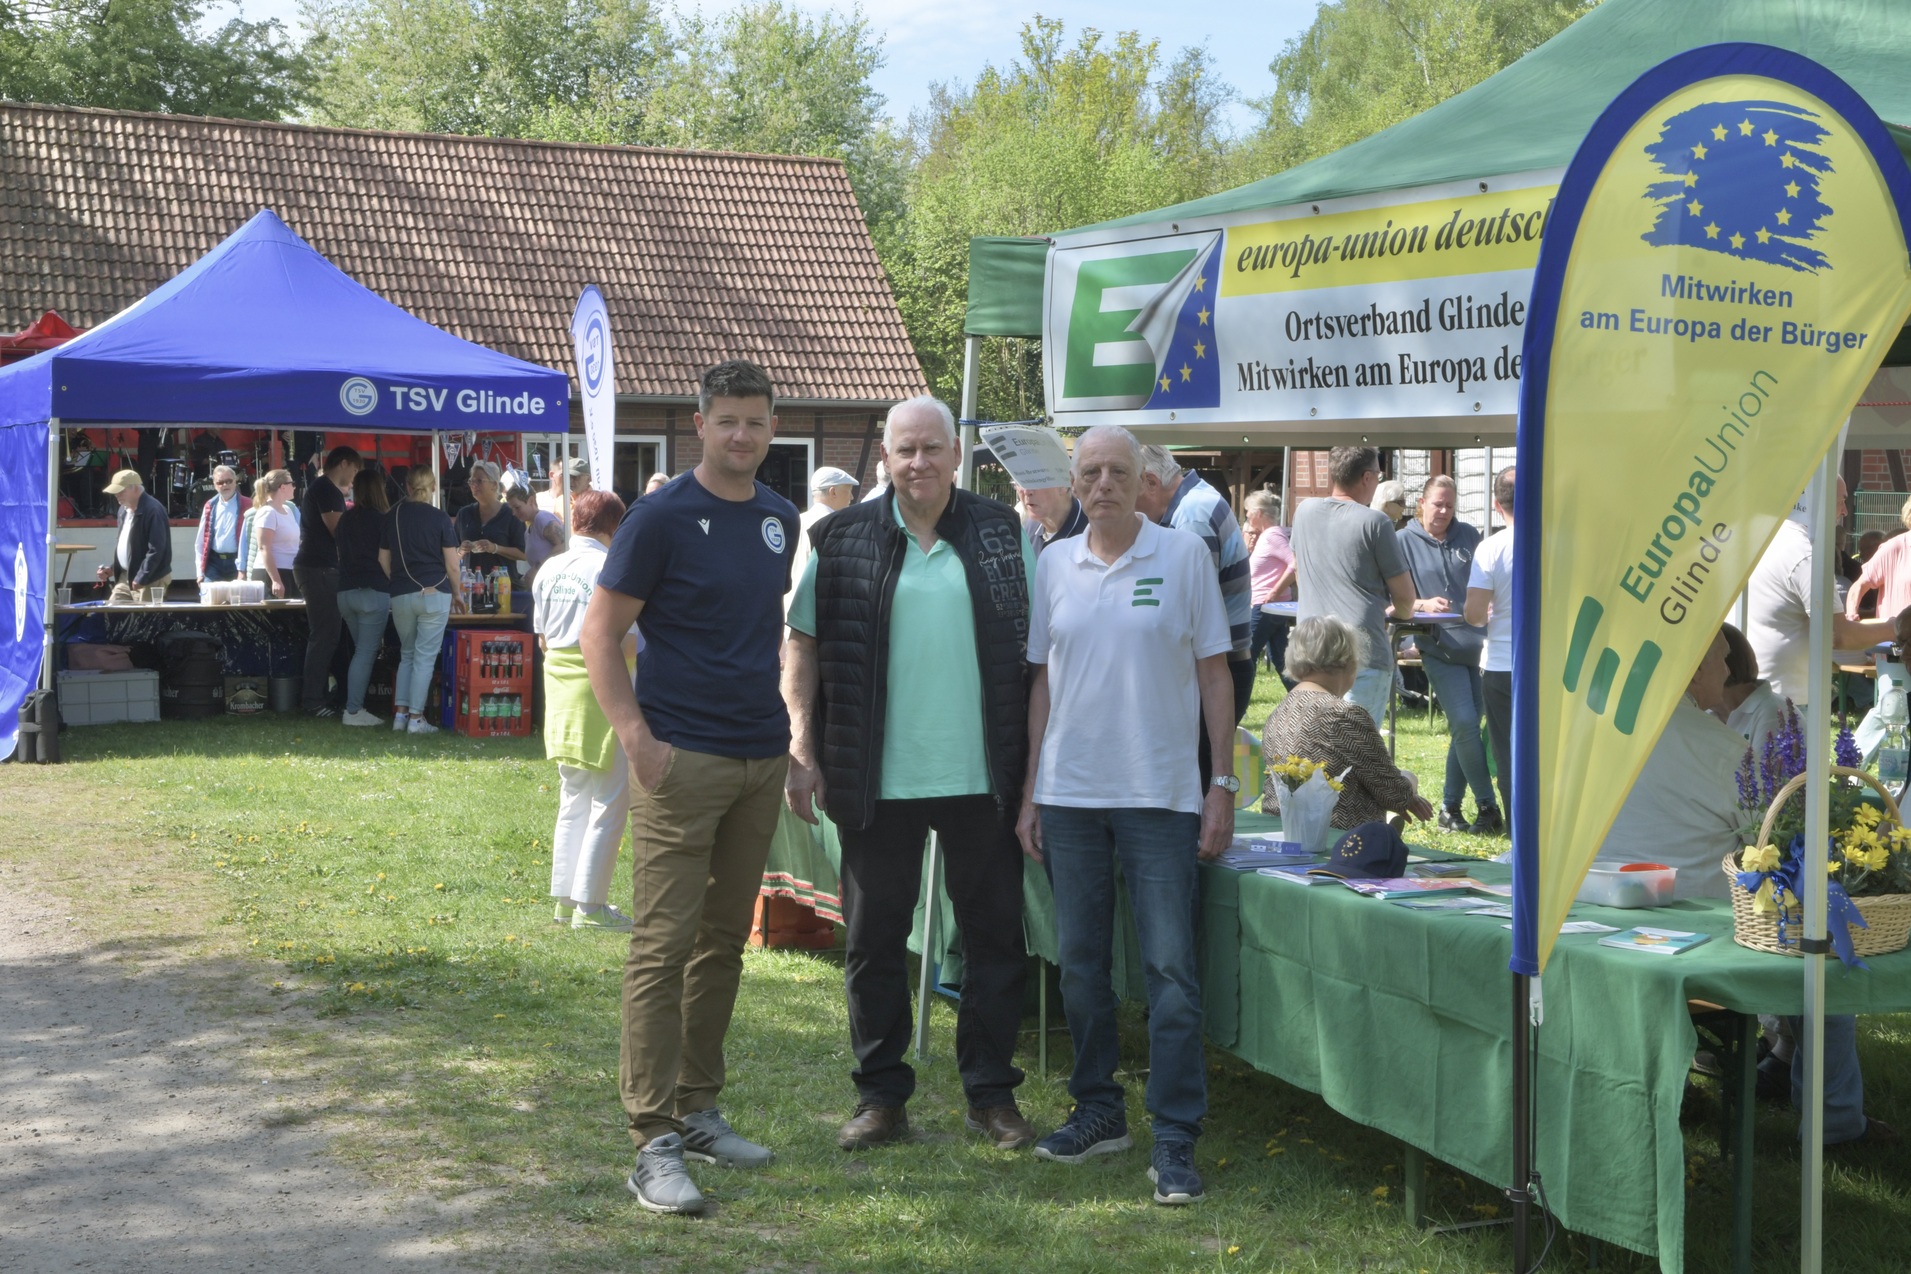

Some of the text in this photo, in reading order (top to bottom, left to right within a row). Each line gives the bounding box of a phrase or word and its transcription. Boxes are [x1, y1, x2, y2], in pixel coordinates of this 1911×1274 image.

[1237, 219, 1429, 279] europa-union
[1661, 273, 1793, 308] Mitwirken
[1285, 290, 1525, 342] Ortsverband Glinde
[1580, 308, 1868, 353] am Europa der Bürger
[1237, 356, 1350, 392] Mitwirken
[1355, 360, 1393, 387] am
[1398, 352, 1488, 393] Europa
[389, 386, 545, 415] TSV Glinde
[1619, 369, 1778, 604] EuropaUnion
[979, 525, 1020, 554] 63
[1660, 522, 1732, 625] Glinde
[230, 701, 264, 710] Krombacher
